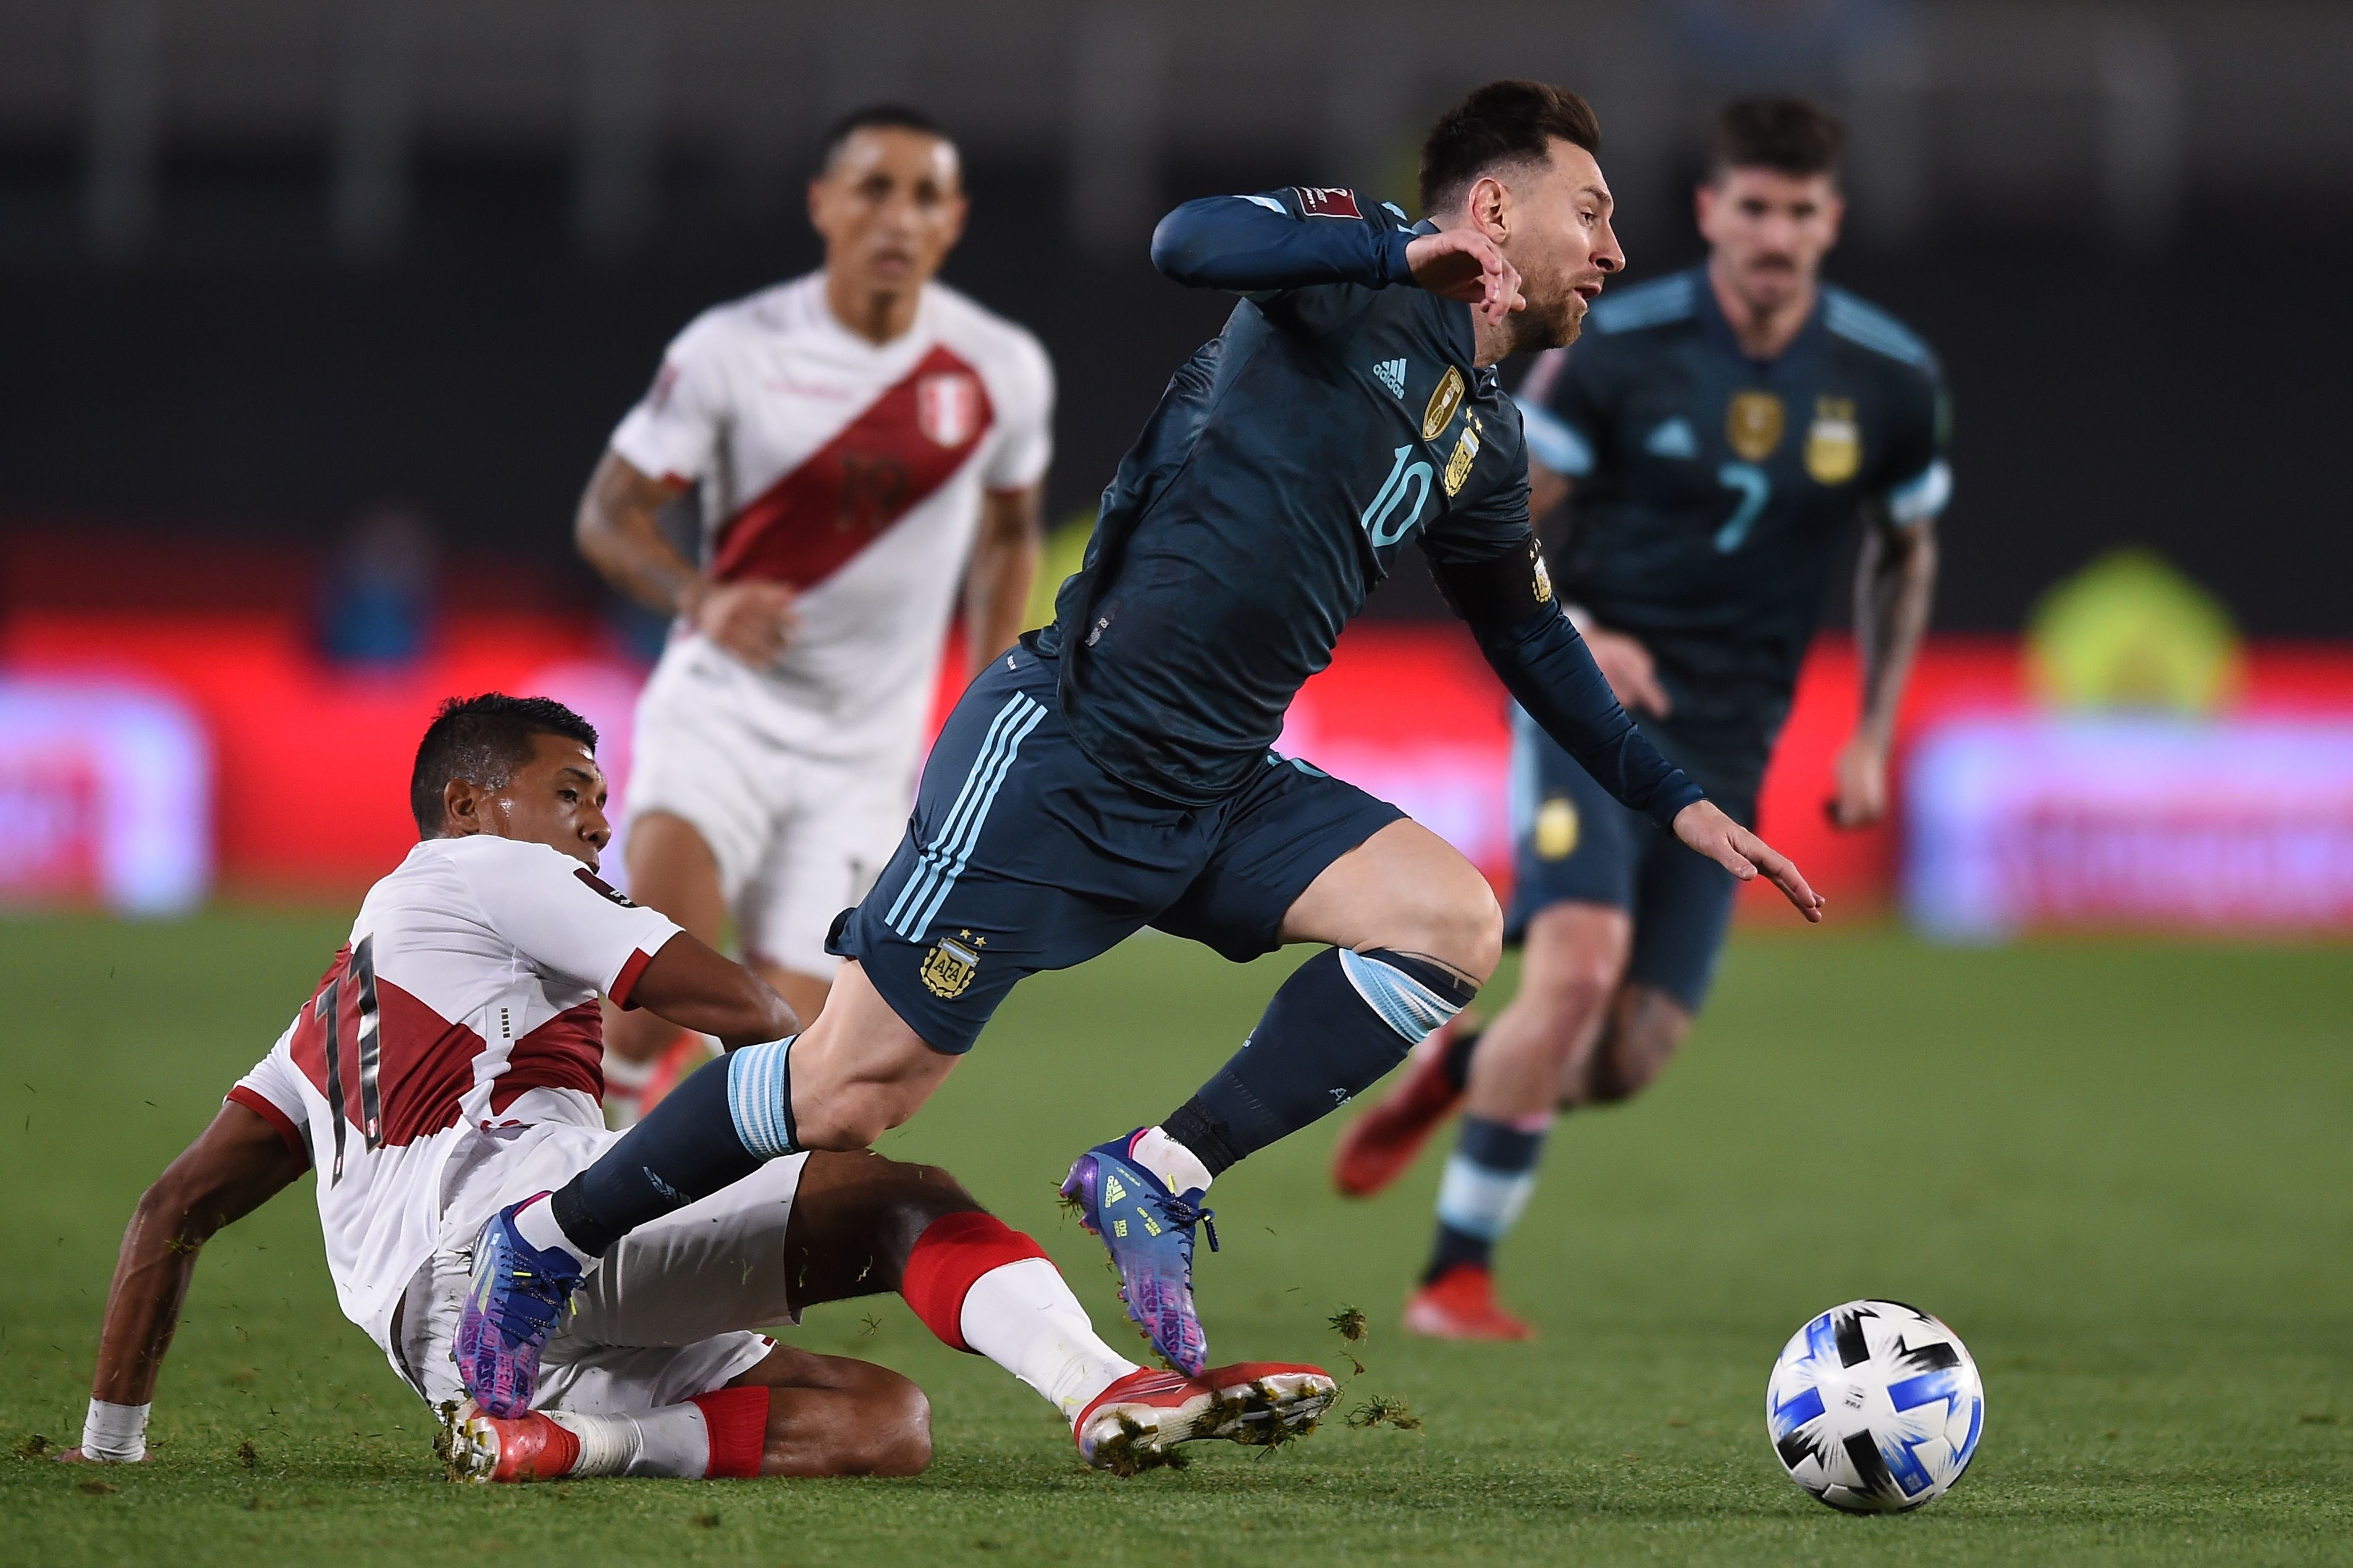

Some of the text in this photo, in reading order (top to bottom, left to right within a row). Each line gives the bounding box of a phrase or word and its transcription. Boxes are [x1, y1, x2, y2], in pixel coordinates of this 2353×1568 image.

[1373, 364, 1405, 400] adidas
[1361, 444, 1433, 548] 10
[1714, 463, 1772, 554] 7
[933, 953, 962, 983] AFA
[315, 931, 383, 1191] 11
[1105, 1175, 1114, 1208] adidas
[1118, 1219, 1127, 1236] 100
